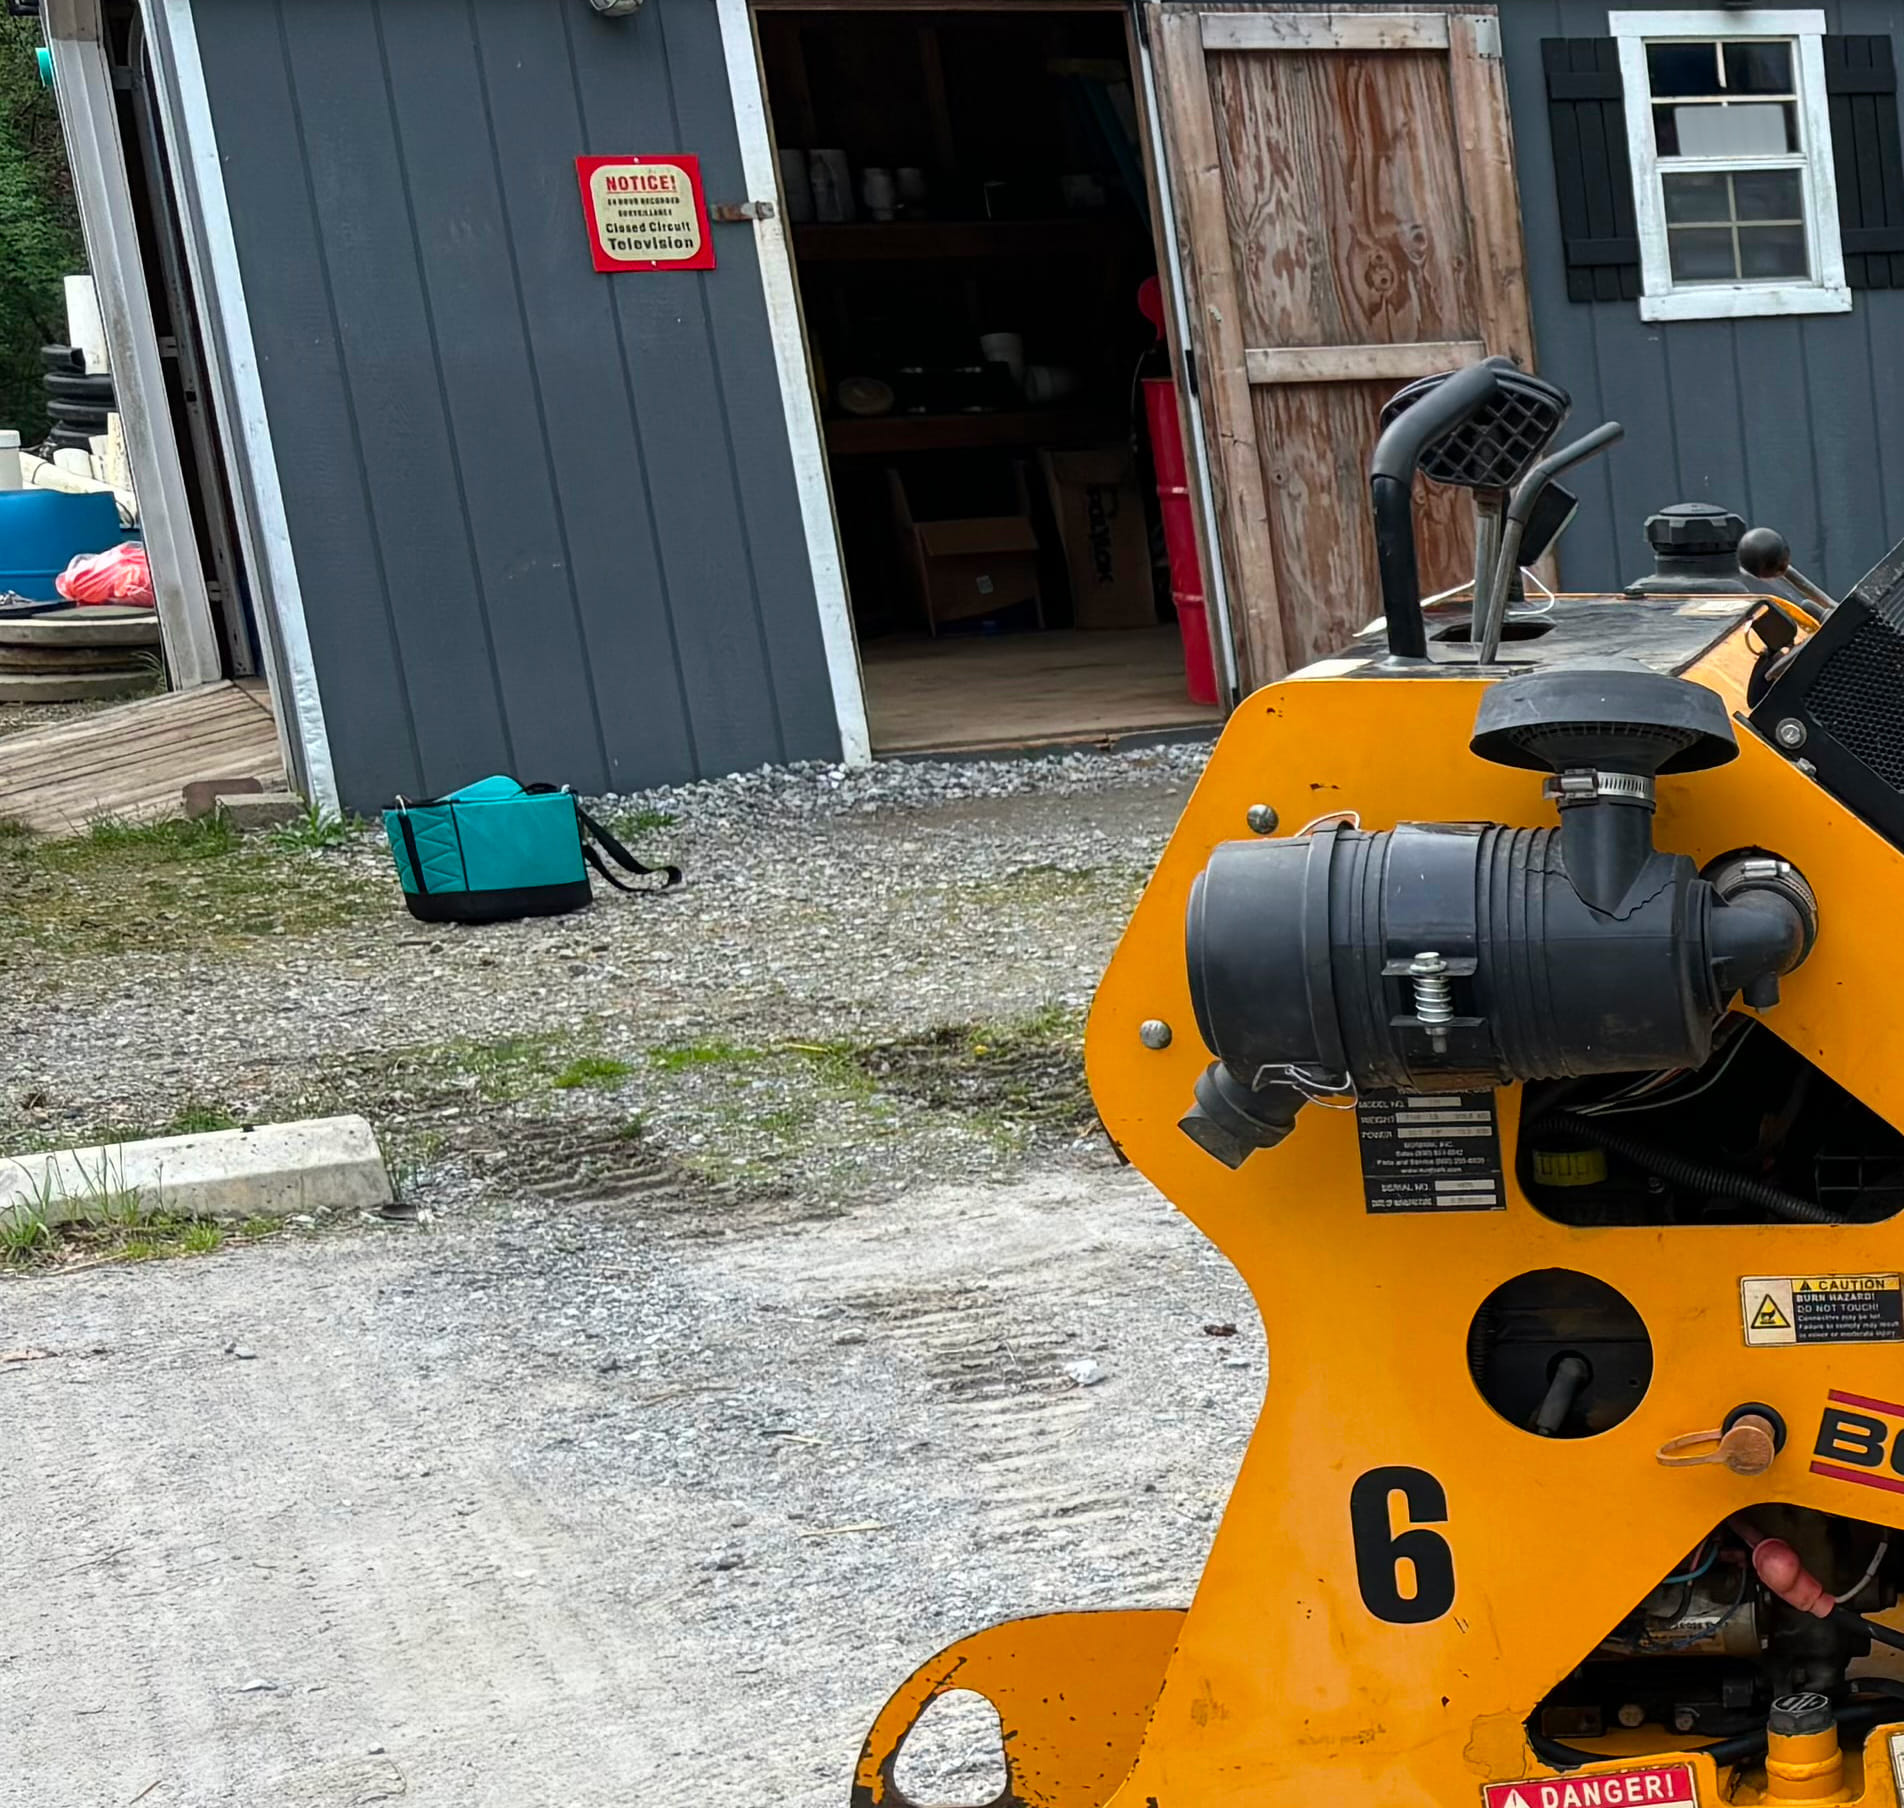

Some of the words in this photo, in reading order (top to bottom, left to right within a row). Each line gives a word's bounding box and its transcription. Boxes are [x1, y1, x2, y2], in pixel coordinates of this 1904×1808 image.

[605, 175, 677, 192] NOTICE!
[605, 222, 646, 233] Closed
[648, 221, 691, 232] Circuit
[608, 236, 694, 251] Television
[1818, 1280, 1885, 1291] CAUTION
[1796, 1294, 1825, 1302] BURN
[1829, 1293, 1875, 1301] HAZARD!
[1816, 1304, 1836, 1312] NOT
[1841, 1303, 1879, 1311] TOUCH!
[1350, 1465, 1456, 1624] 6
